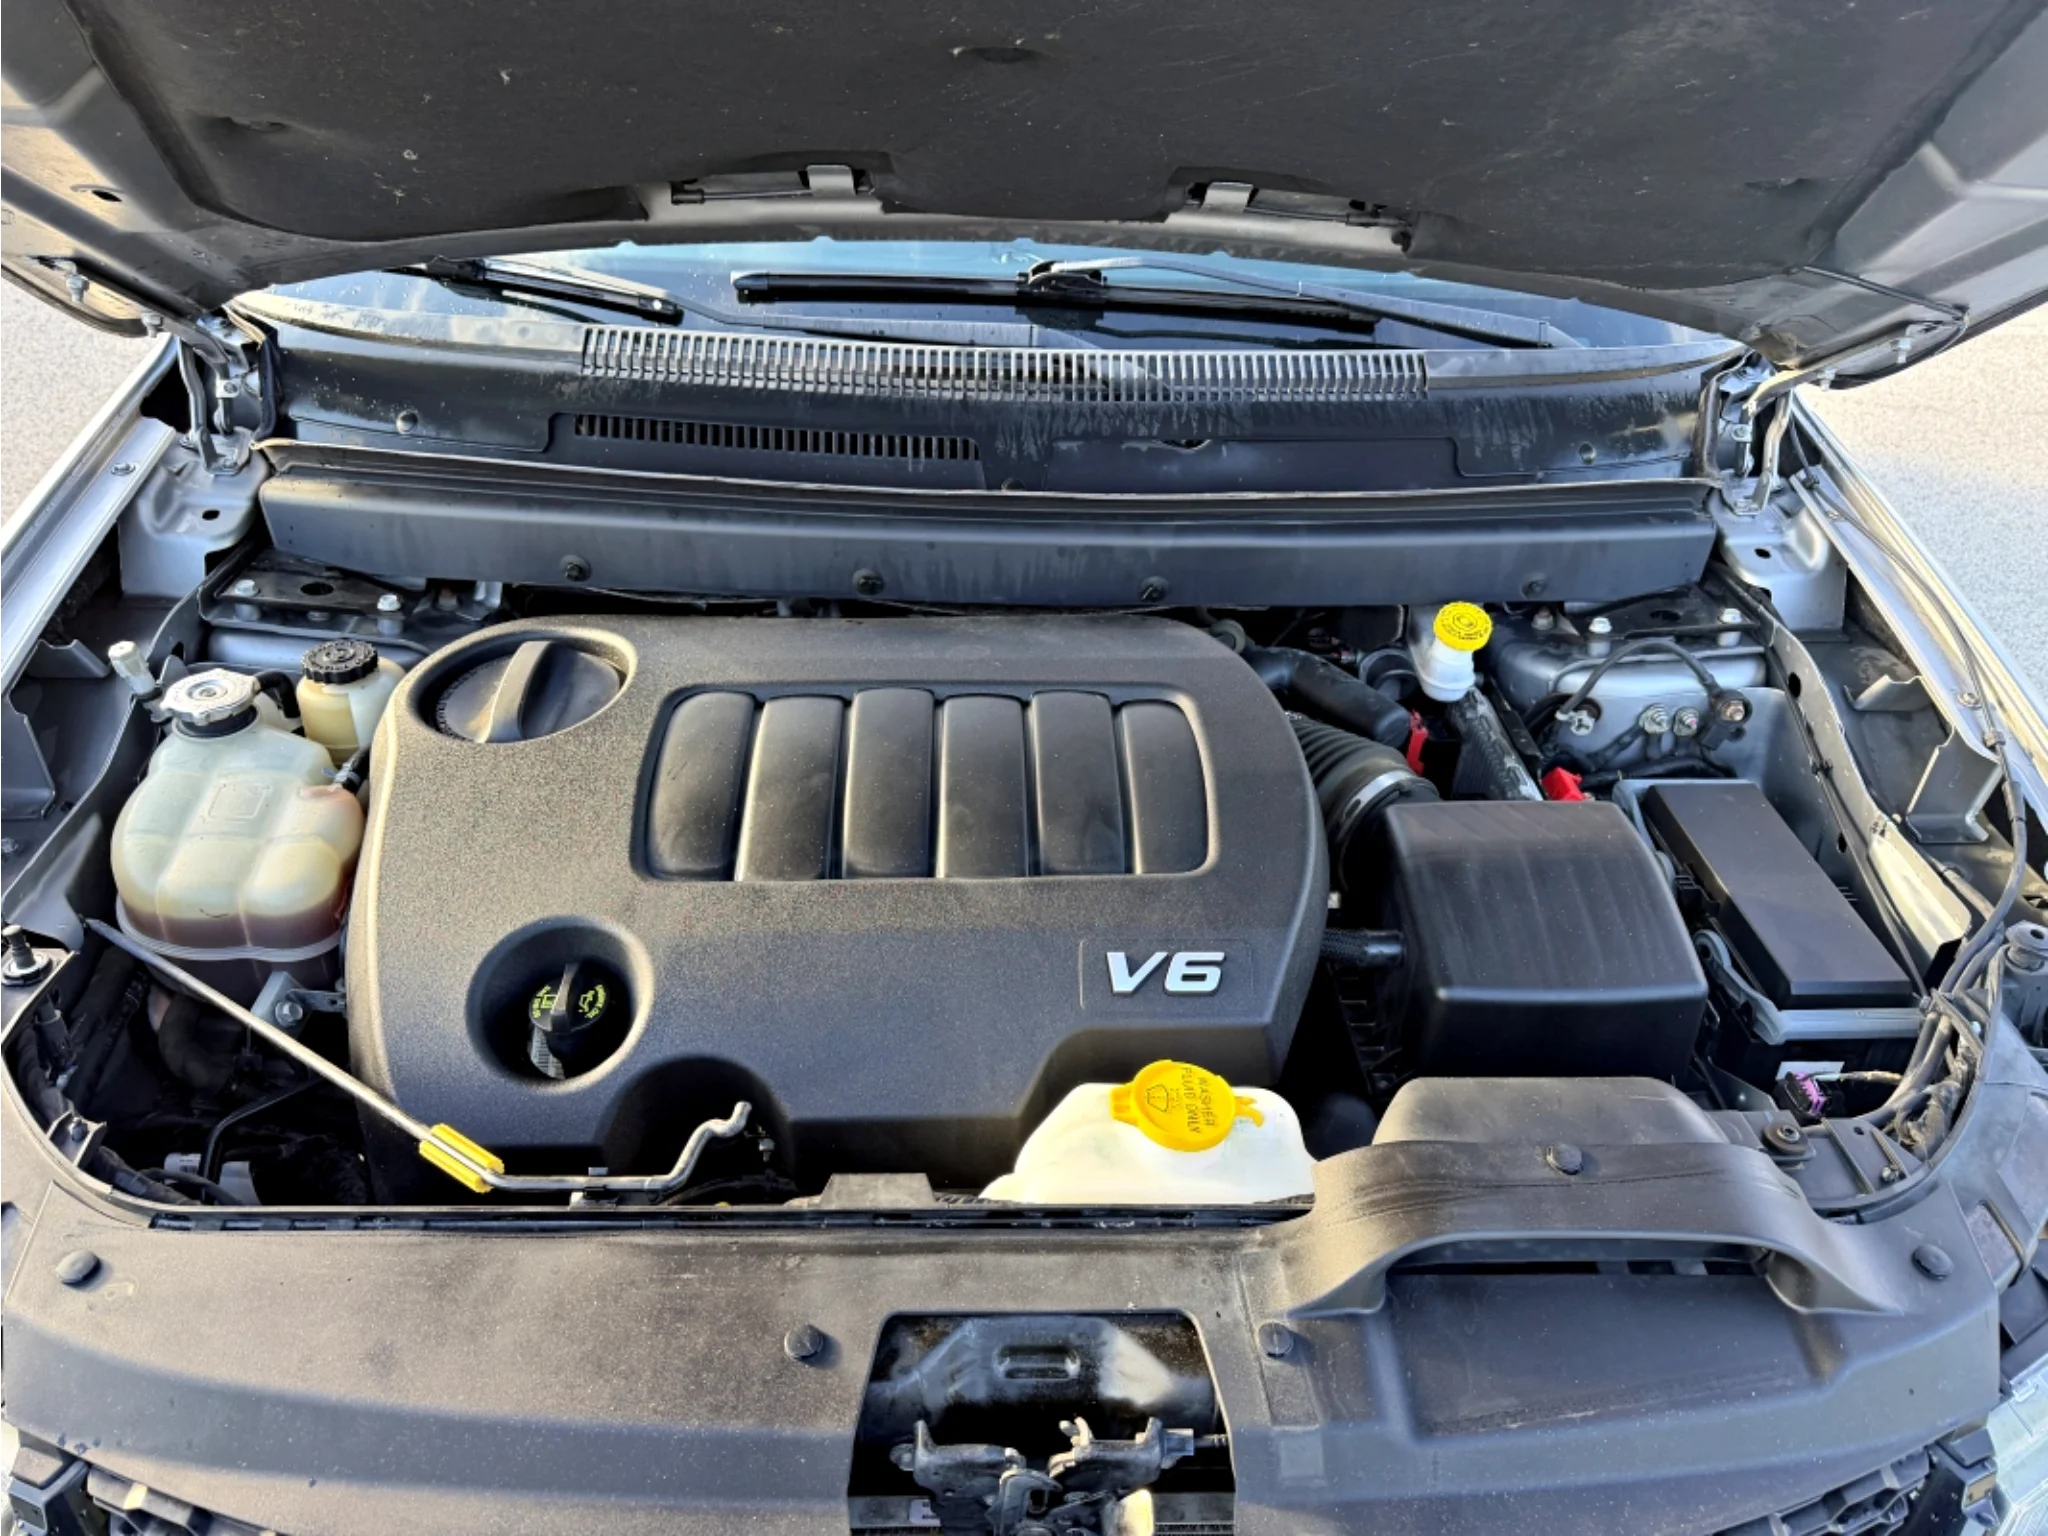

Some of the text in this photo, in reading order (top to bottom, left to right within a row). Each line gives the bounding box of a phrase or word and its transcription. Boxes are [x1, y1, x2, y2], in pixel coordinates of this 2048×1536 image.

[1106, 951, 1226, 996] V6
[1180, 1066, 1202, 1134] FLUID ONLY
[1197, 1076, 1216, 1127] WASHER
